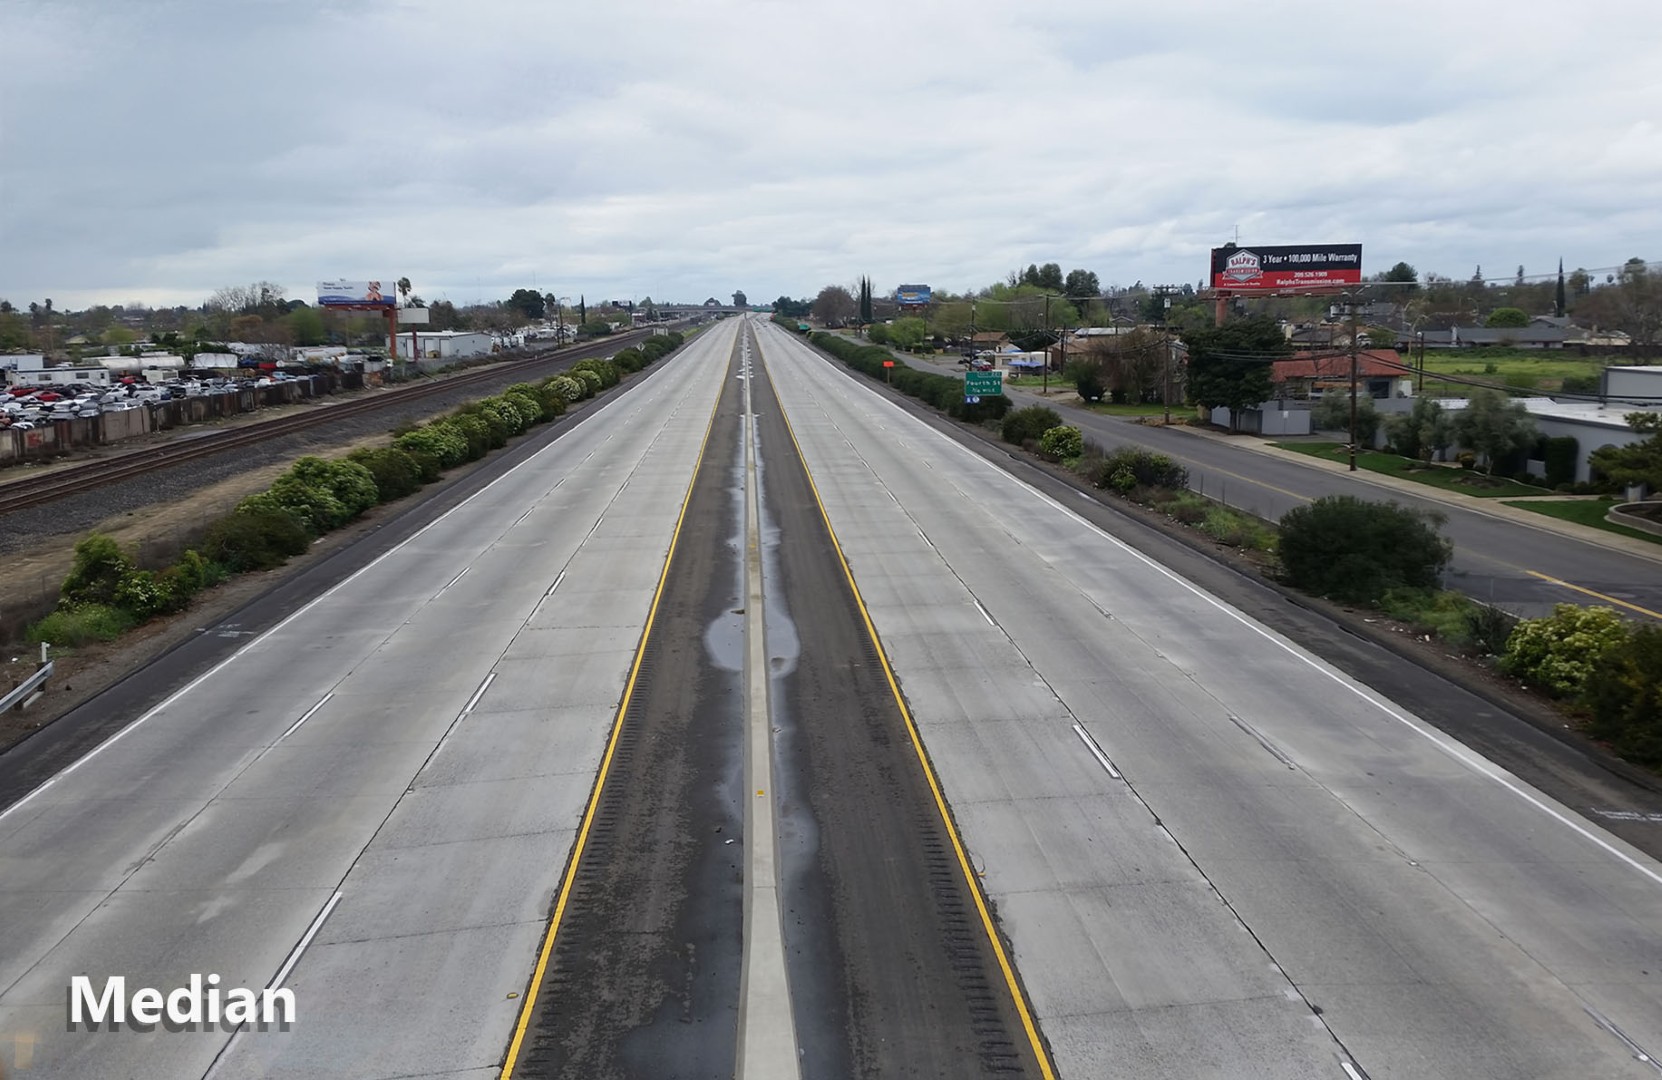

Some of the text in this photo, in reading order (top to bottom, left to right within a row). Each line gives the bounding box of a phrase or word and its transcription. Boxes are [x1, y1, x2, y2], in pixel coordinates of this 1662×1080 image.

[1263, 253, 1358, 264] 3 Year 100,000 Mile Warranty
